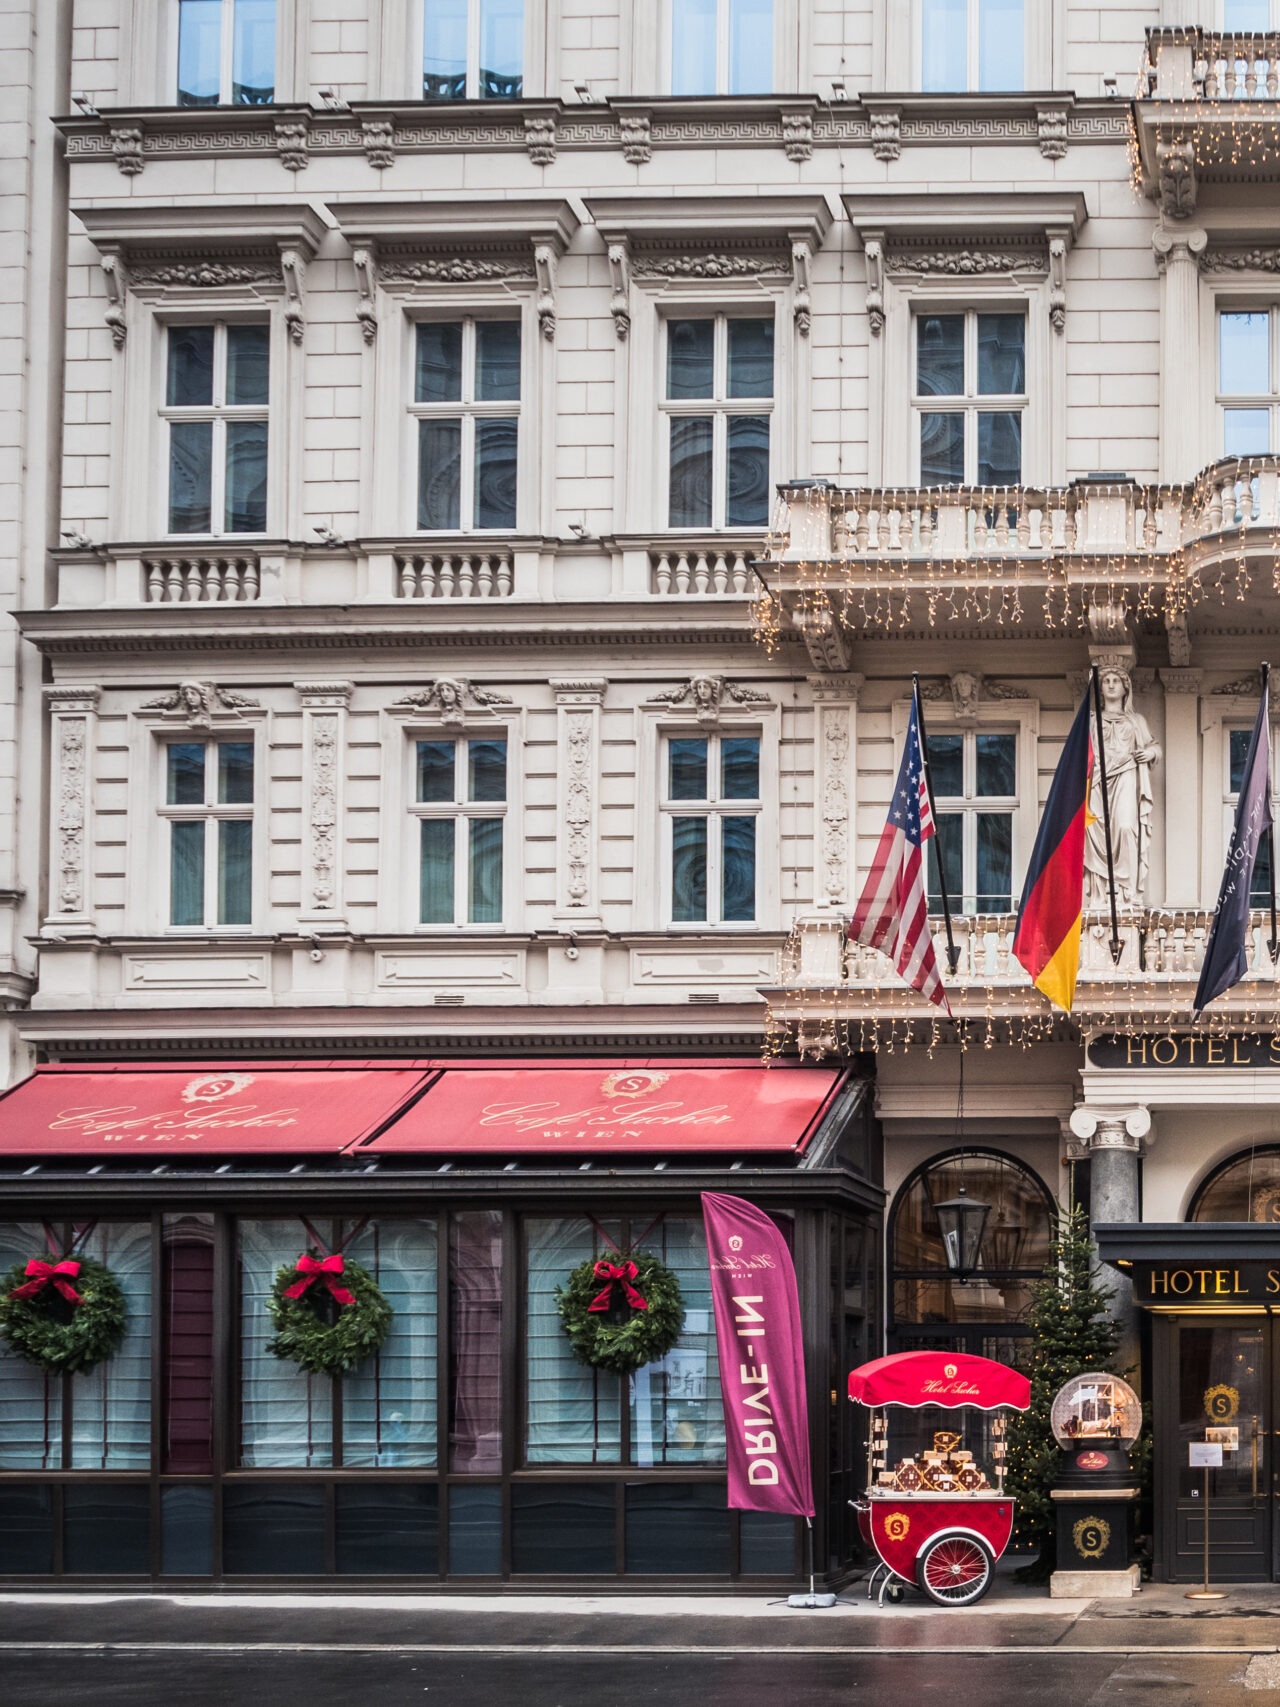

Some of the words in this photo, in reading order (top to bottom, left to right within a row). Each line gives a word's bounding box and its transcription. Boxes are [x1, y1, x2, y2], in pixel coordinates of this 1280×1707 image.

[1126, 1037, 1251, 1064] HOTEL
[621, 1078, 643, 1090] S
[154, 1105, 299, 1129] Sacher
[587, 1101, 734, 1125] Sacher
[1150, 1269, 1249, 1294] HOTEL
[920, 1379, 950, 1394] Hotel
[950, 1380, 981, 1396] Sacher
[1216, 1398, 1227, 1414] S
[893, 1522, 901, 1534] S
[1086, 1531, 1097, 1547] S
